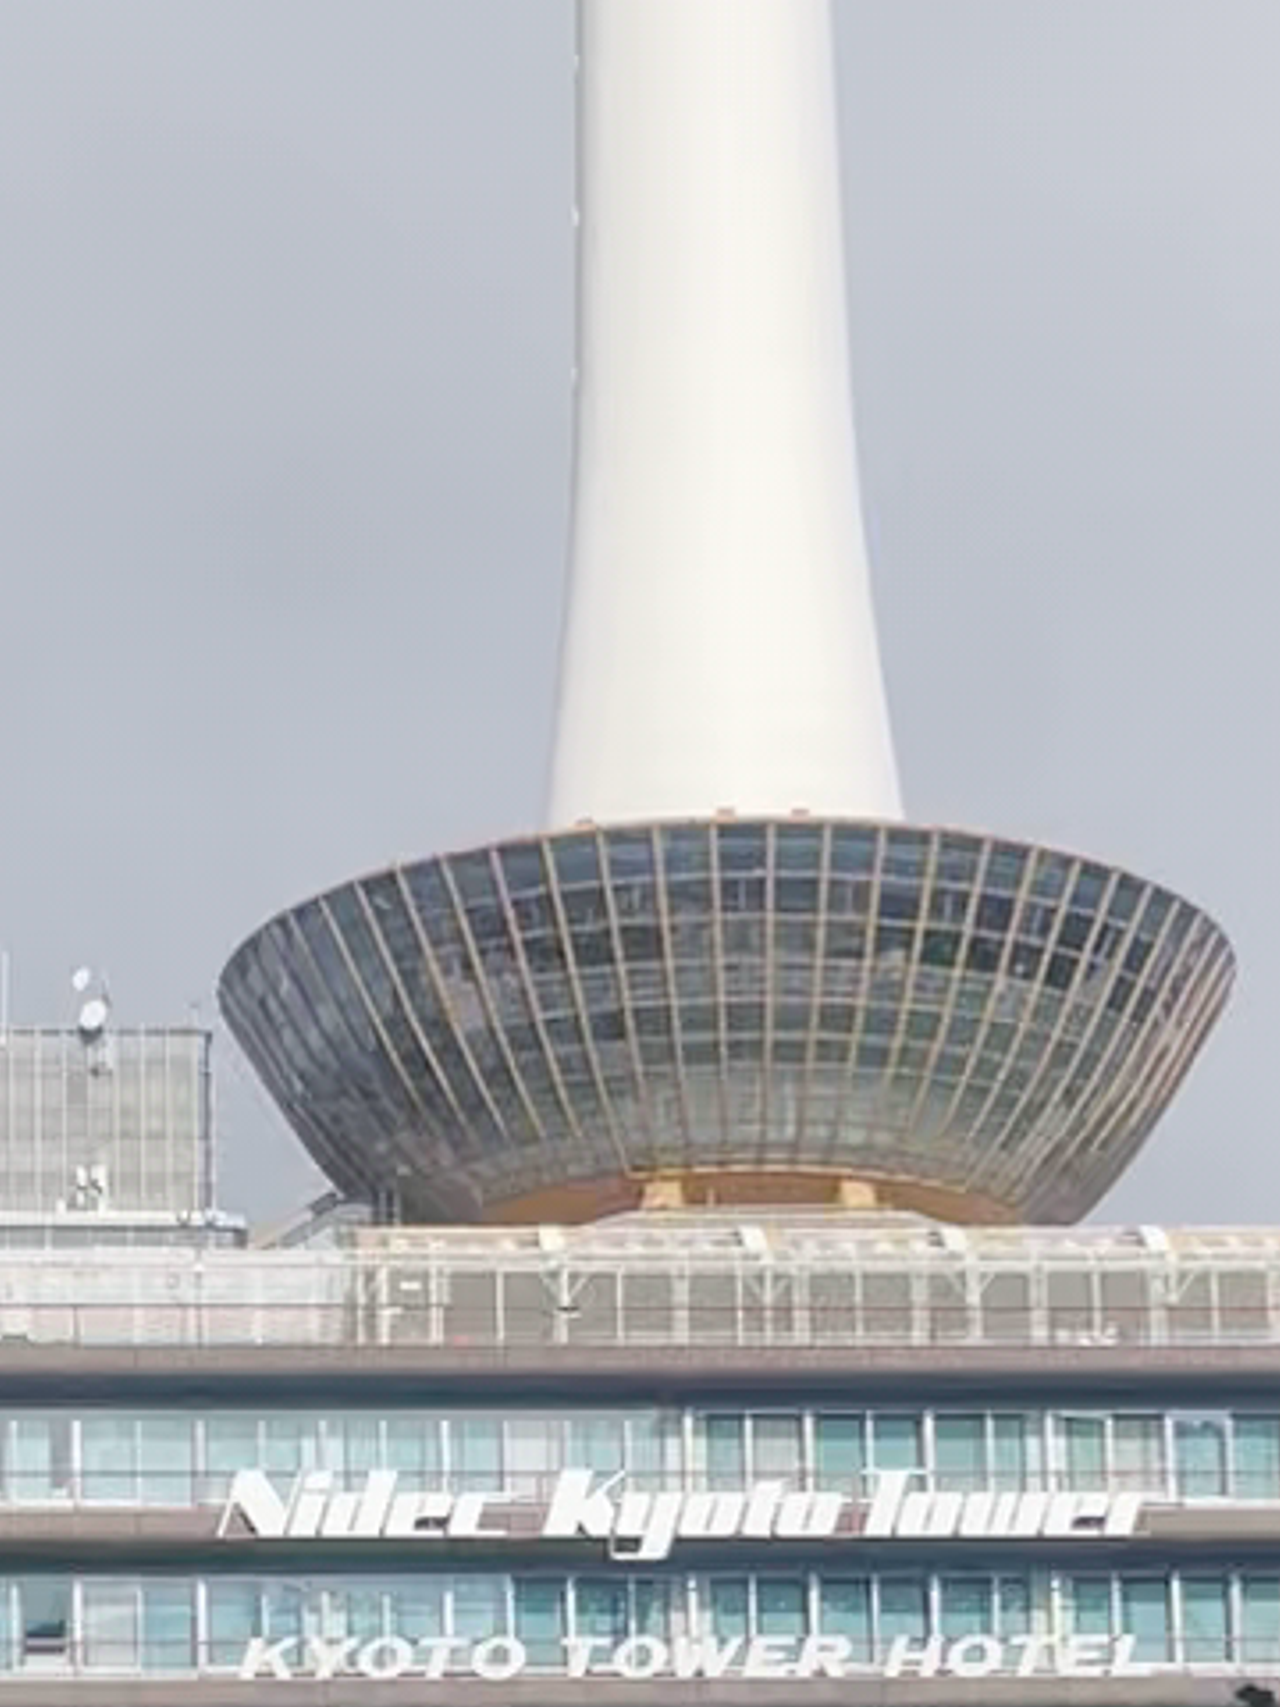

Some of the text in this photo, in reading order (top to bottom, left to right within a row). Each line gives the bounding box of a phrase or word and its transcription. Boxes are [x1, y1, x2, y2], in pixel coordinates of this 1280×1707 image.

[218, 1467, 1148, 1560] Nidec Kyoto Tower
[238, 1634, 1153, 1680] KYOTO TOWER HOTEL
